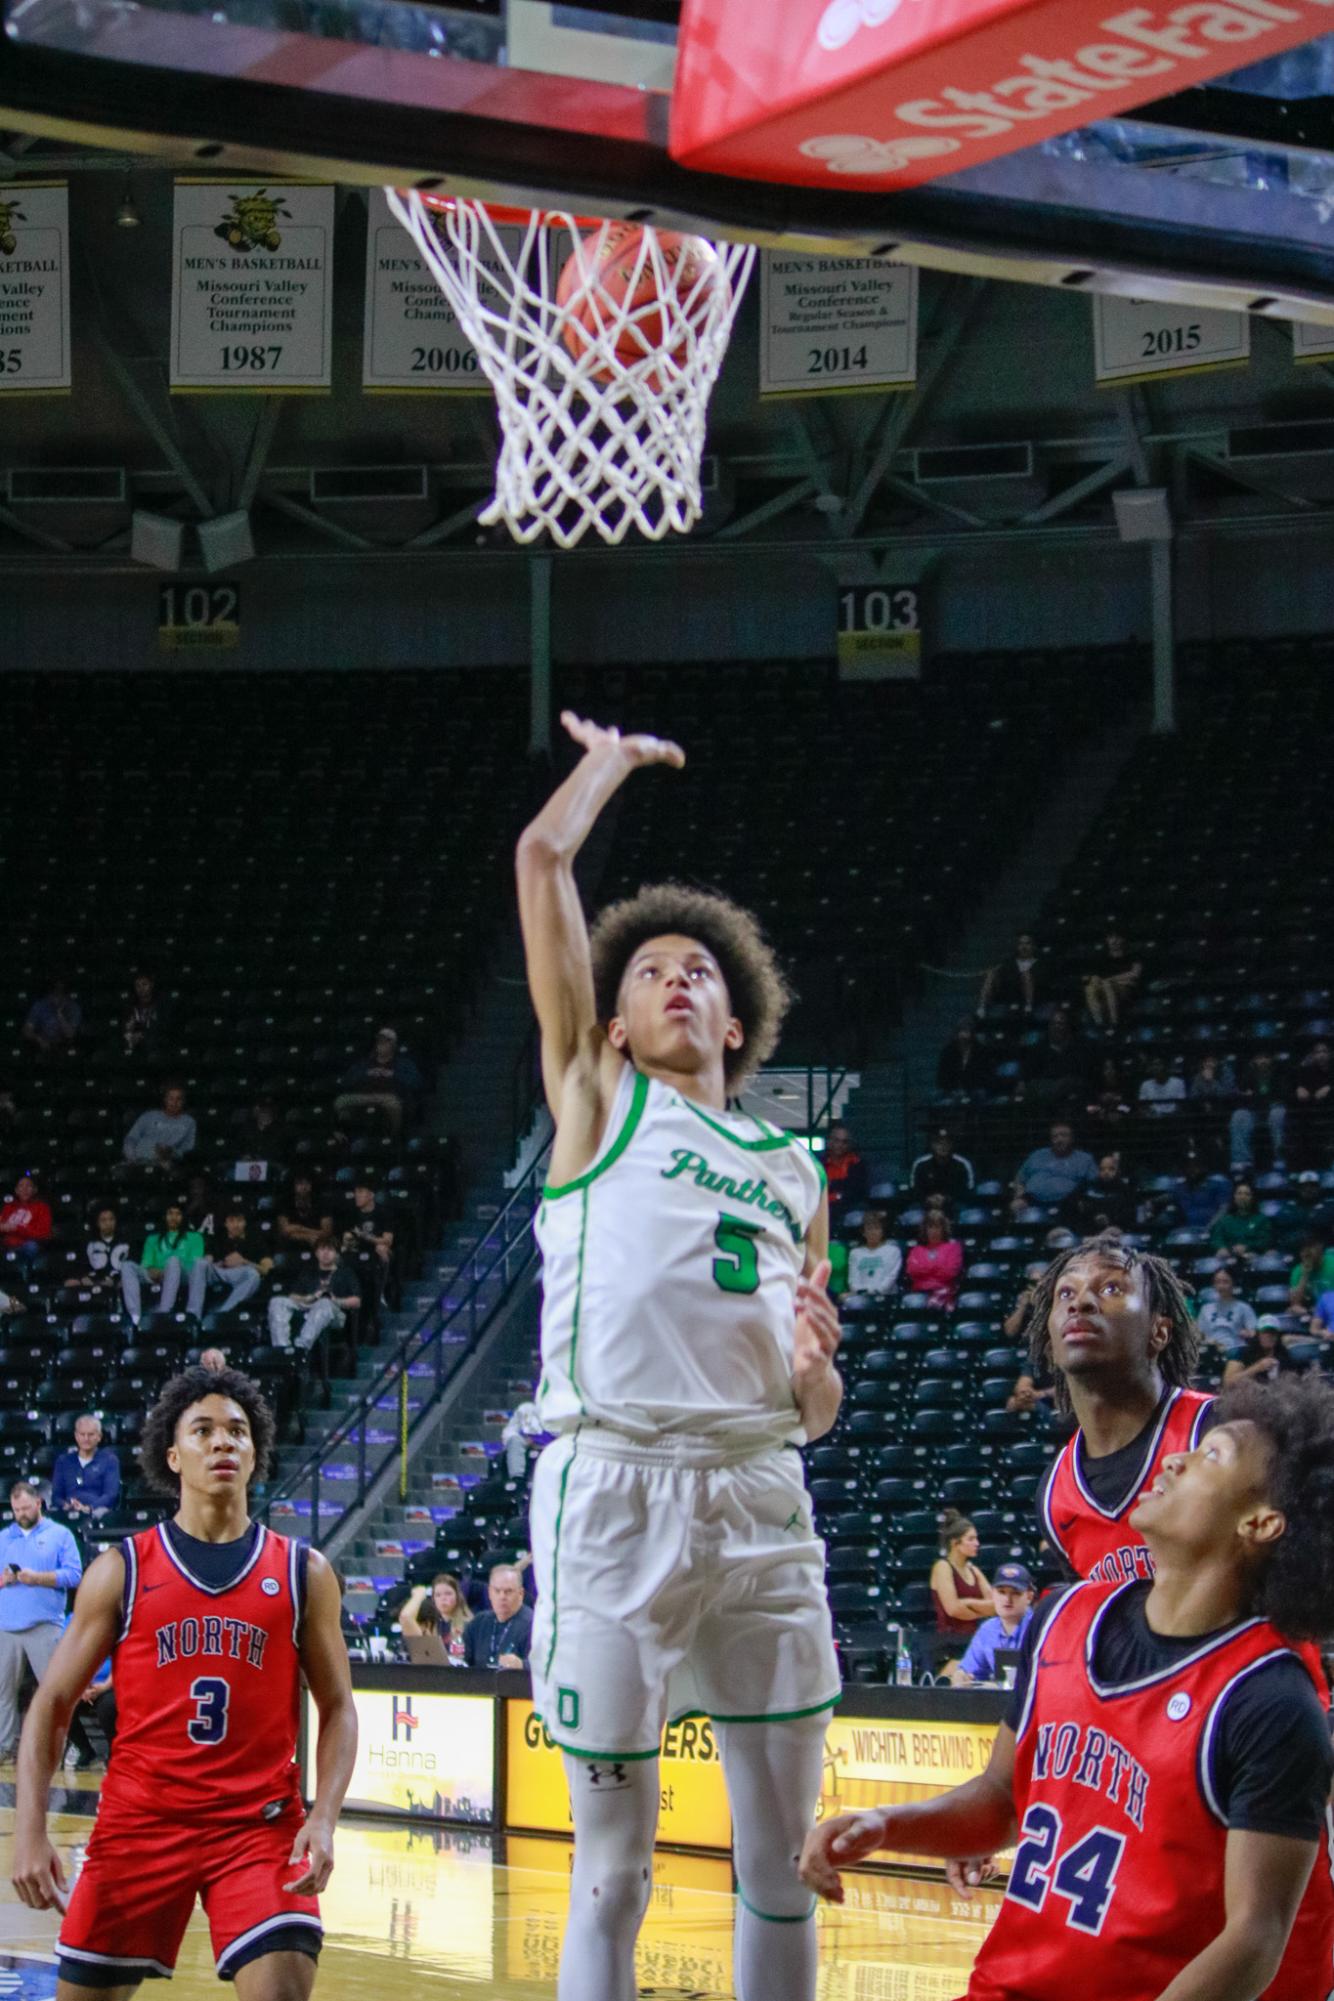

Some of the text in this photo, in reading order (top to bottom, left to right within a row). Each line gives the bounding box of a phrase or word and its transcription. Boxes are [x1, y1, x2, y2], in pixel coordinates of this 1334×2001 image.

[184, 257, 322, 270] MEN'S BASKETBALL
[378, 259, 421, 271] MEN'S
[771, 262, 814, 274] MEN'S
[2, 283, 45, 297] Valley
[196, 280, 308, 295] Missouri Valley
[210, 293, 294, 305] Conference
[784, 279, 894, 296] Missouri Valley
[207, 307, 296, 319] Tournament
[798, 294, 880, 308] Conference
[210, 320, 293, 334] Champions
[771, 318, 907, 335] Tournament Champions
[788, 311, 834, 323] Regular
[836, 308, 877, 319] Season
[1141, 325, 1201, 356] 2015
[220, 346, 283, 370] 1987
[411, 347, 477, 372] 2006
[808, 345, 868, 373] 2014
[161, 587, 237, 629] 102
[841, 590, 918, 631] 103
[712, 1210, 761, 1295] 5
[155, 1615, 269, 1669] NORTH
[187, 1676, 231, 1745] 3
[369, 1743, 438, 1770] Hanna
[851, 1729, 908, 1767] WICHITA
[911, 1733, 974, 1770] BREWING
[1030, 1721, 1150, 1832] NORTH
[1005, 1801, 1127, 1936] 24
